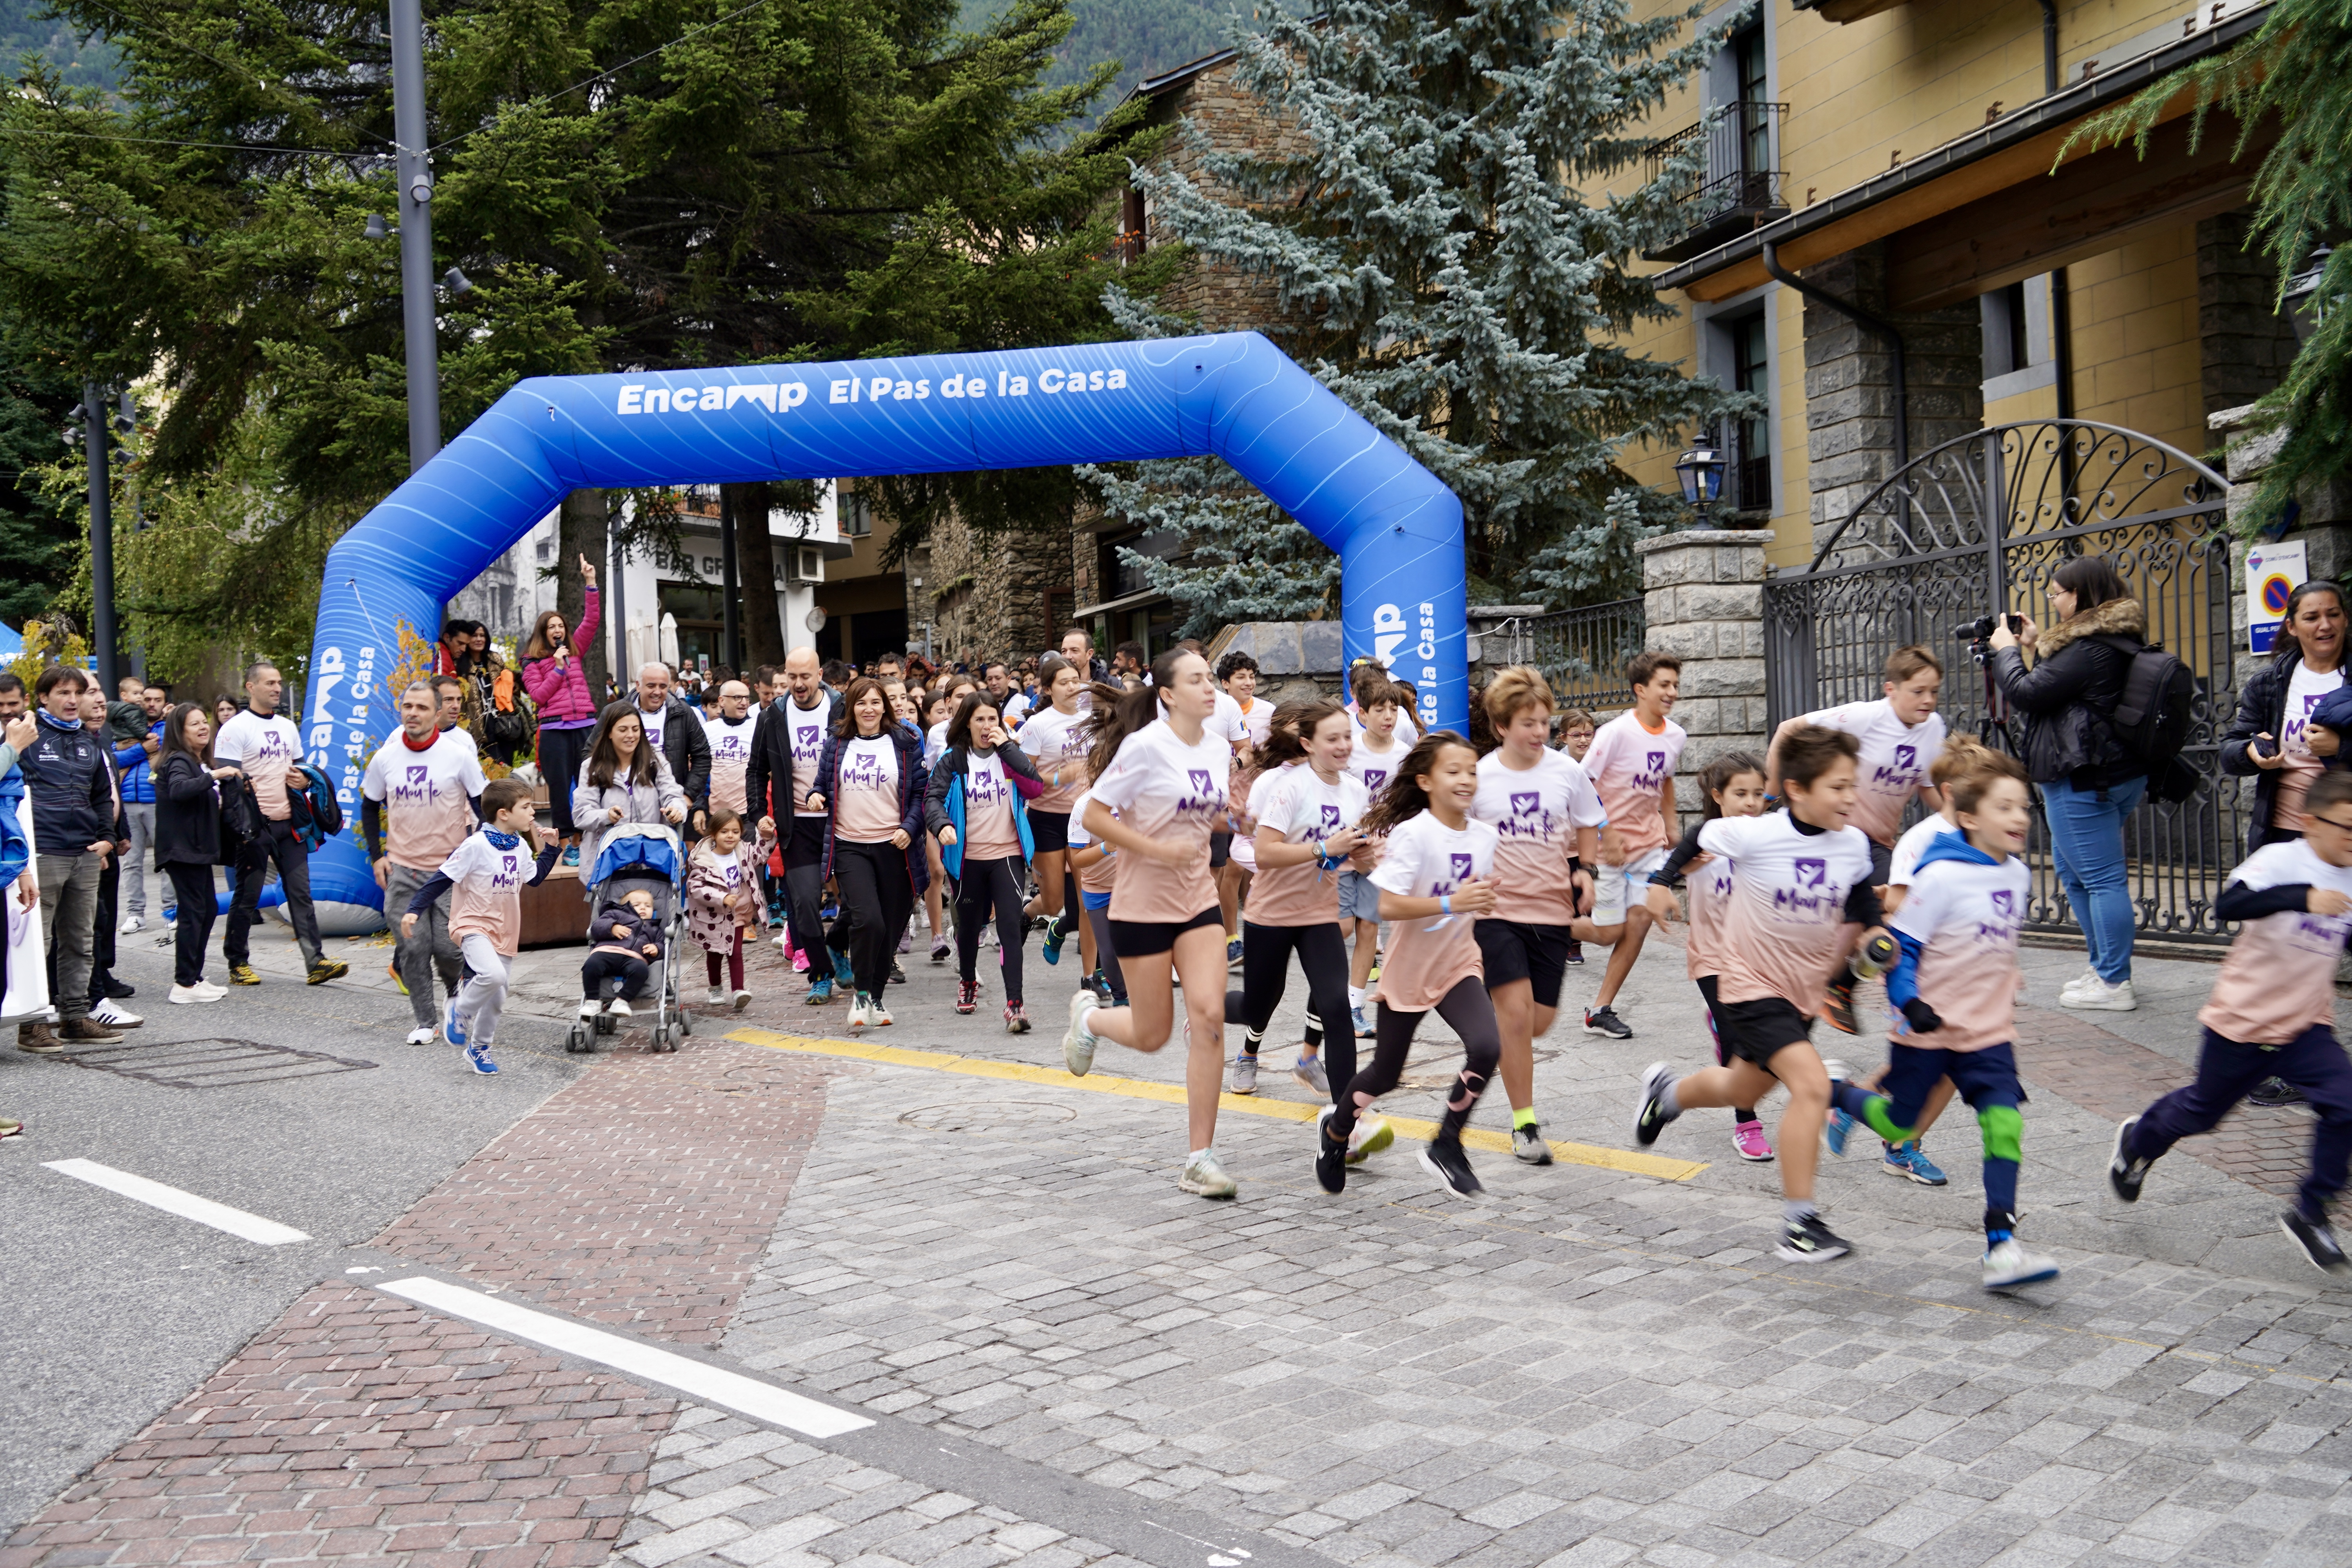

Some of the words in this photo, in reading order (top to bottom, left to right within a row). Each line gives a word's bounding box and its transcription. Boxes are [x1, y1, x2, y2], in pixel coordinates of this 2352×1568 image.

[617, 381, 808, 415] Encamp
[829, 377, 860, 404] El
[870, 377, 930, 402] Pas
[940, 374, 987, 398] de
[998, 371, 1029, 397] la
[1038, 368, 1126, 394] Casa
[1417, 603, 1435, 660] Casa
[351, 647, 375, 699] Casa
[1417, 666, 1437, 688] la
[307, 647, 345, 770] camp
[347, 705, 368, 725] la
[1419, 694, 1437, 725] de
[344, 730, 365, 759] de
[336, 766, 359, 804] Pas
[844, 765, 890, 791] Mou-te
[966, 779, 1008, 806] Mou-te
